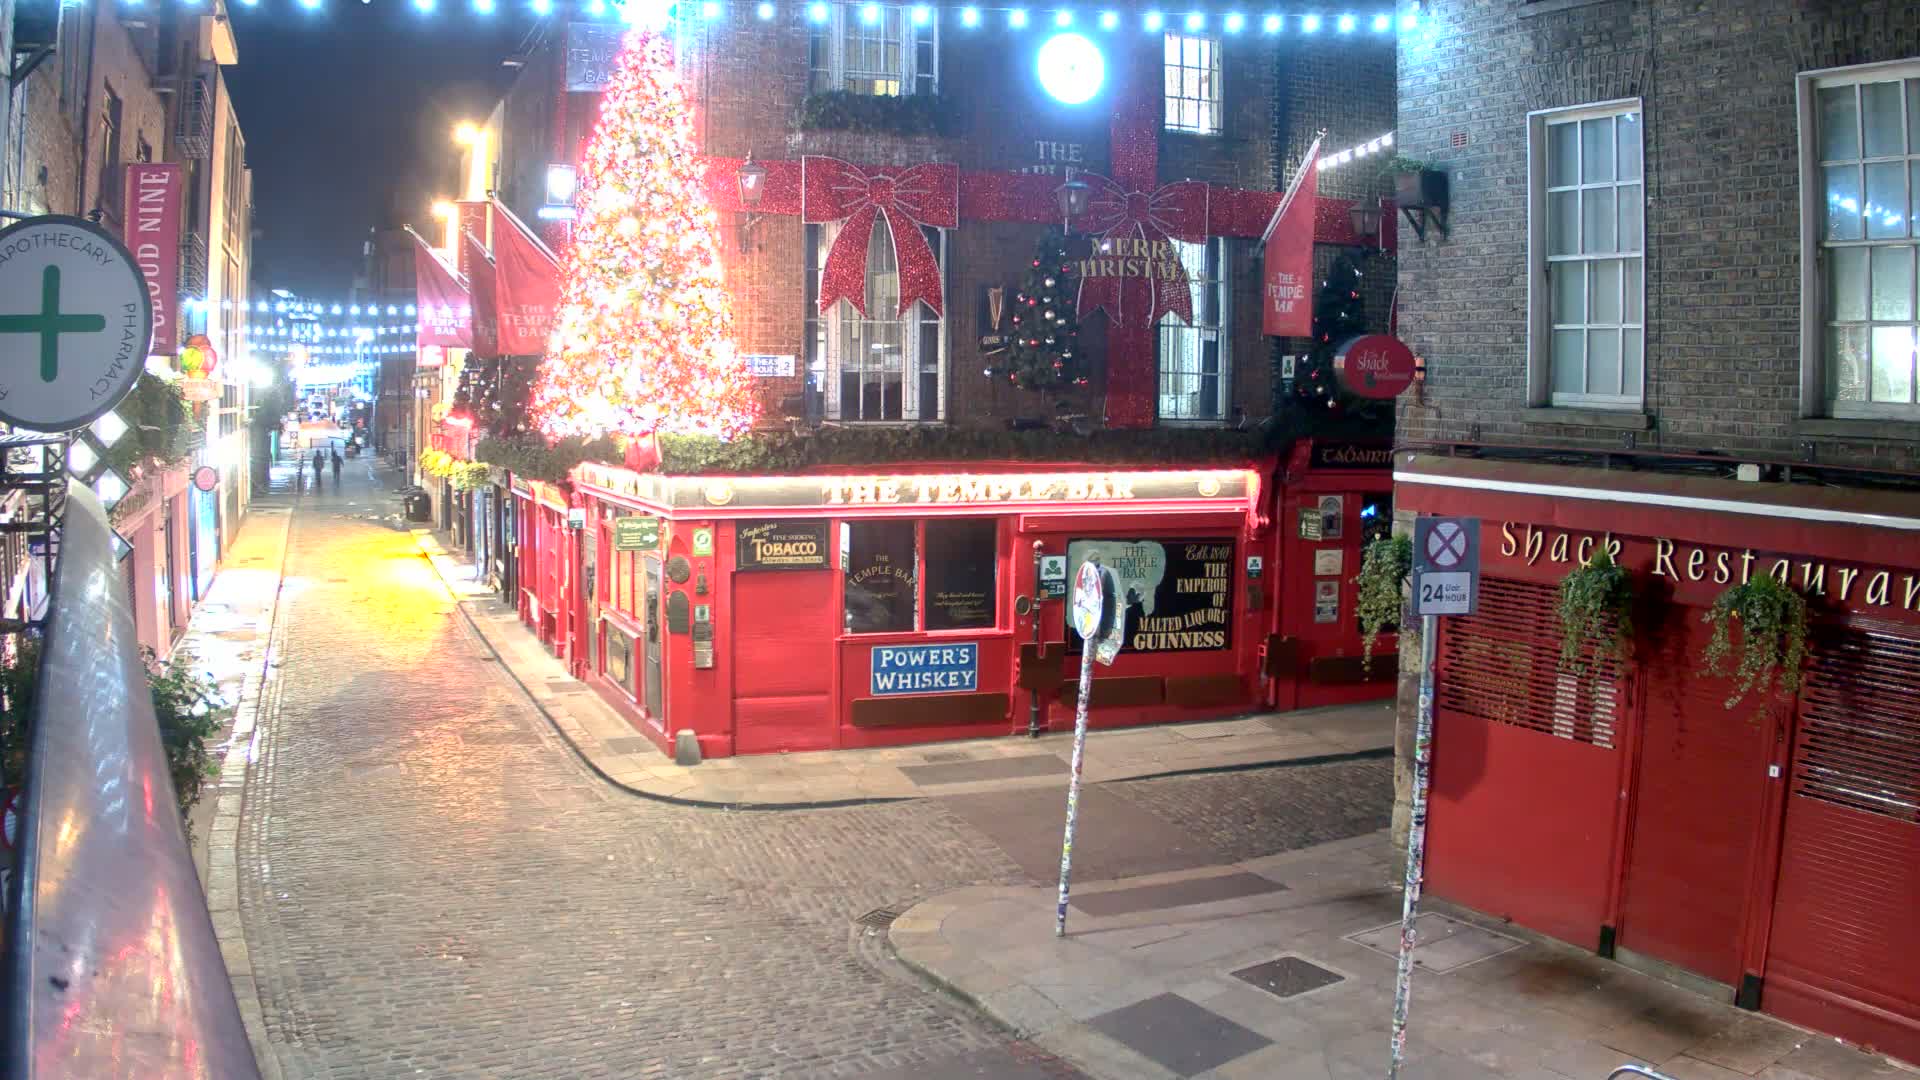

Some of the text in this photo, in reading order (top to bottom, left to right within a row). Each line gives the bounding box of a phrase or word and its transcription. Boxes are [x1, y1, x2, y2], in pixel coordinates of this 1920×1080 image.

[1034, 140, 1084, 163] THE
[138, 172, 170, 233] NINE
[0, 232, 114, 268] APOTHECARY
[1092, 237, 1180, 261] MERRY
[1278, 272, 1296, 284] THE
[1268, 284, 1305, 299] TEMPLE
[520, 304, 545, 314] THE
[434, 327, 457, 336] BAR
[89, 302, 137, 401] PHARMACY
[784, 361, 791, 371] 2
[826, 473, 1136, 504] THE TEMPLE BAR
[1122, 546, 1146, 557] THE
[1501, 520, 1622, 567] Shack
[1112, 557, 1158, 569] TEMPLE
[1204, 562, 1227, 578] THE
[847, 565, 915, 588] TEMPLE BAR
[1122, 568, 1146, 579] BAR
[1176, 578, 1227, 593] EMPEROR
[1422, 584, 1444, 603] 24
[1212, 593, 1226, 608] OF
[1445, 594, 1467, 602] HOUR
[1138, 616, 1182, 632] MALTED
[1133, 631, 1225, 650] GUINNESS
[881, 648, 970, 667] POWER'S
[874, 670, 975, 690] WHISKEY
